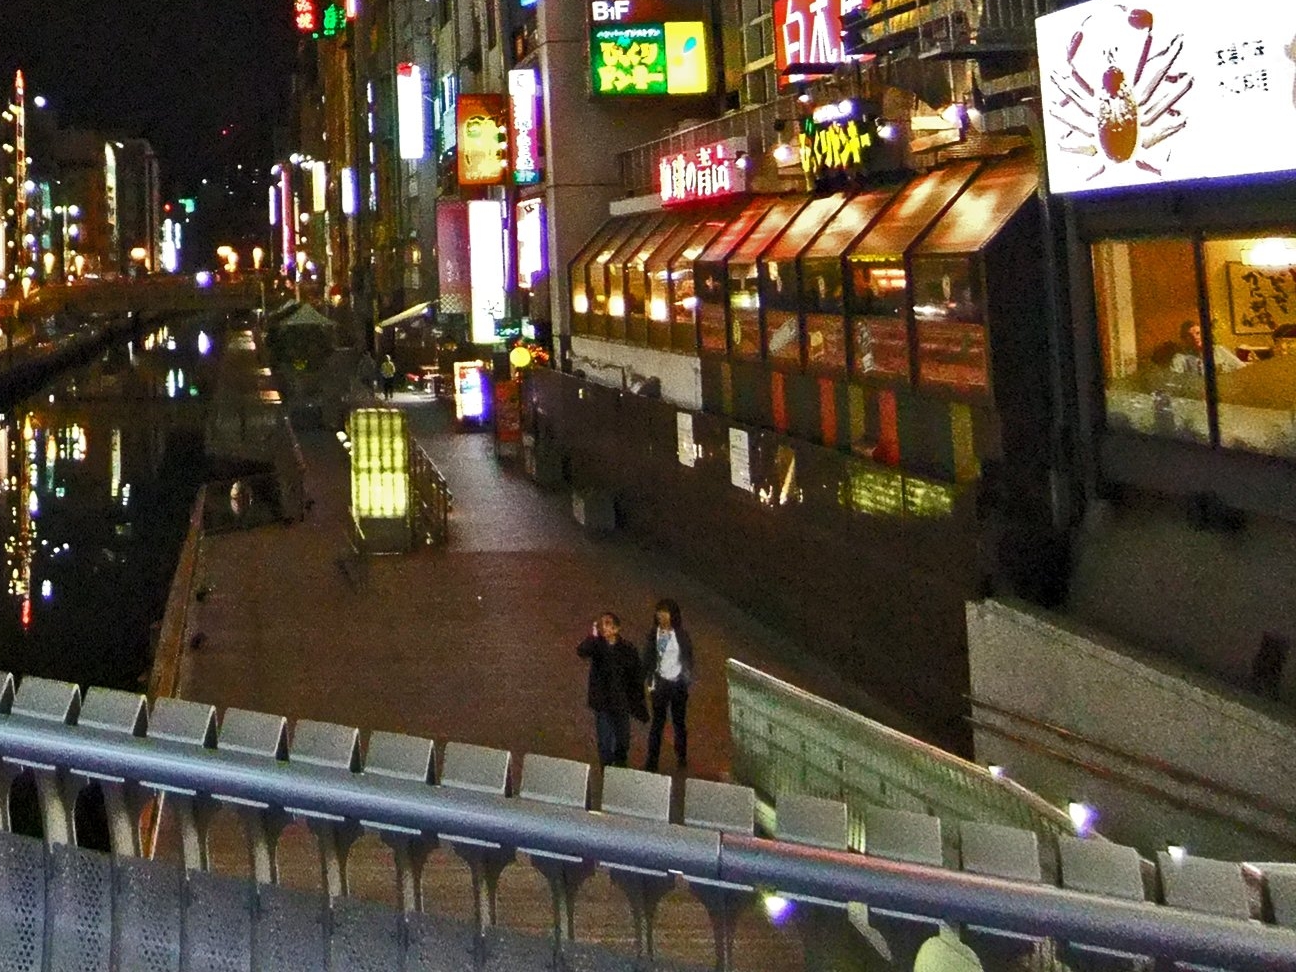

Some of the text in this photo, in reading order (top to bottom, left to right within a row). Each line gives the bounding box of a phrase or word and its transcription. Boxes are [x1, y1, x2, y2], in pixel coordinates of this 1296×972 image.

[592, 0, 630, 21] B1F
[597, 64, 665, 92] ドンキー
